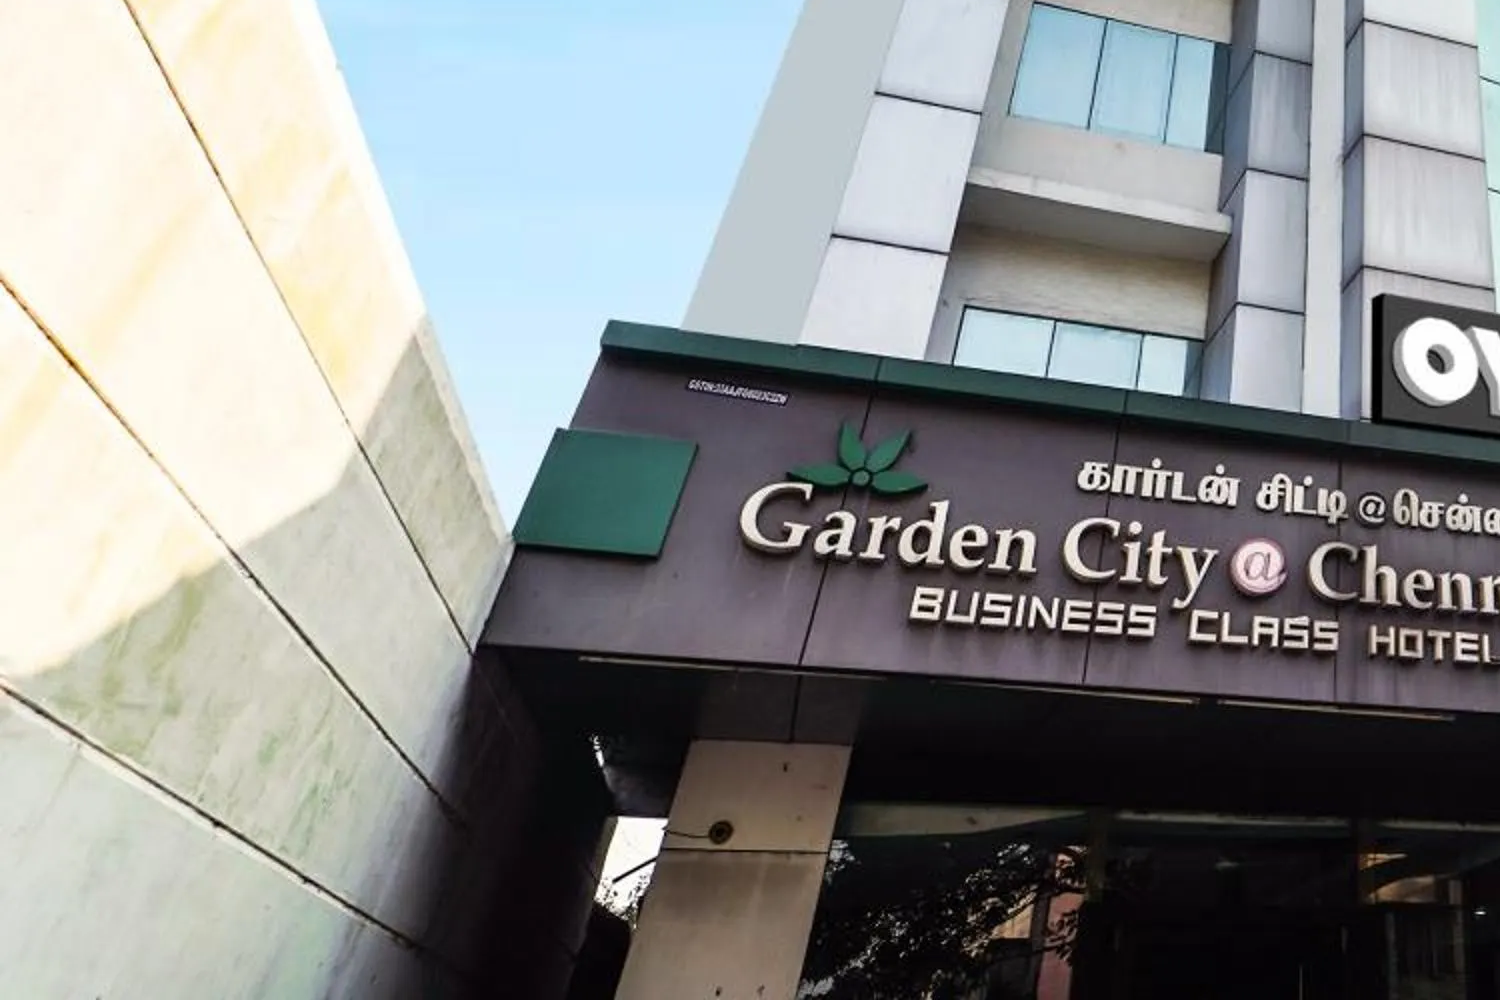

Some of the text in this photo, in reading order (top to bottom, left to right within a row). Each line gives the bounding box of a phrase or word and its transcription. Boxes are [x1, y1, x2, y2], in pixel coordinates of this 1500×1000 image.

[1077, 457, 1241, 508] கார்டன்
[1255, 471, 1349, 527] சிட்டி
[739, 481, 1038, 580] Garden
[1062, 516, 1218, 610] City
[909, 586, 1157, 639] BUSINESS
[1188, 609, 1339, 653] CLASS
